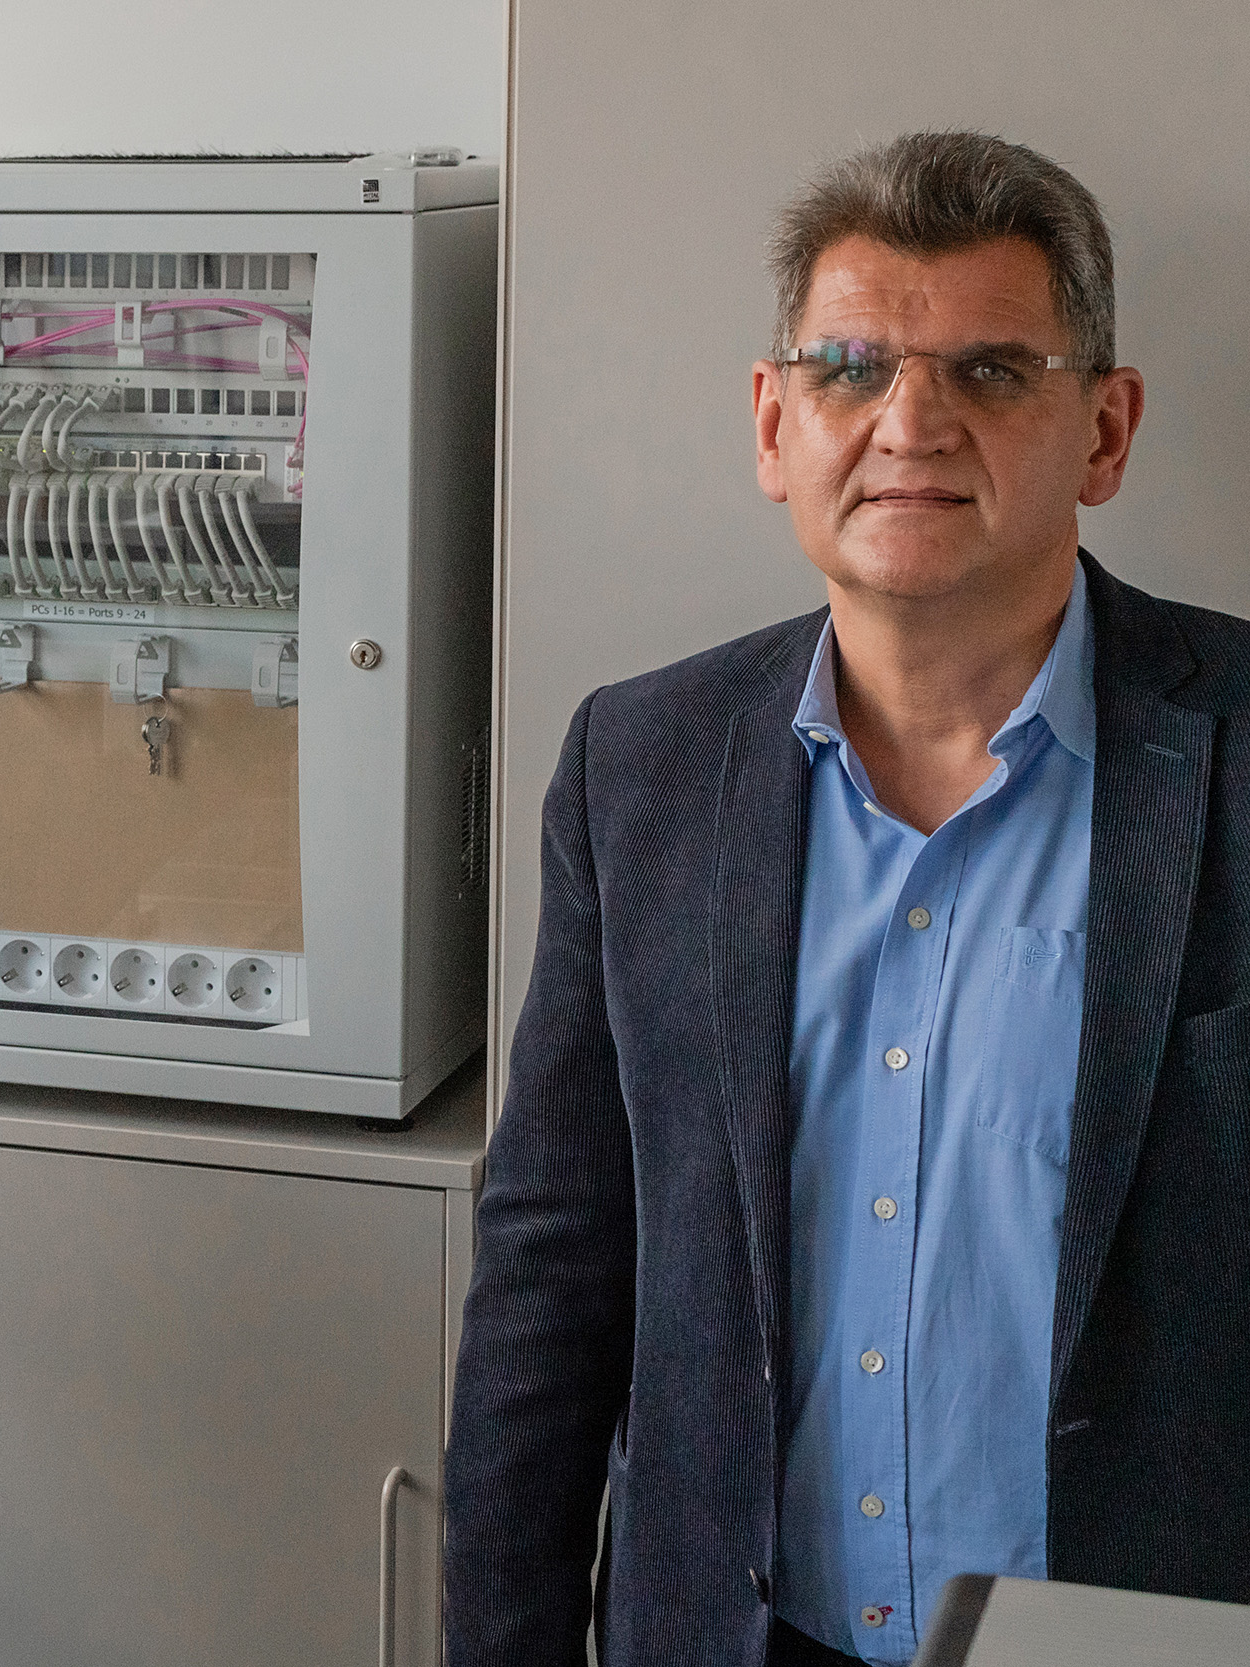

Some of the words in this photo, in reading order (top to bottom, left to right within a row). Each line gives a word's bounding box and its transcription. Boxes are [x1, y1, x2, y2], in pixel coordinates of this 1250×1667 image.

[31, 604, 50, 615] PCs
[53, 605, 75, 616] 1-16
[88, 607, 114, 618] Ports
[116, 608, 123, 618] 9
[134, 610, 146, 619] 24
